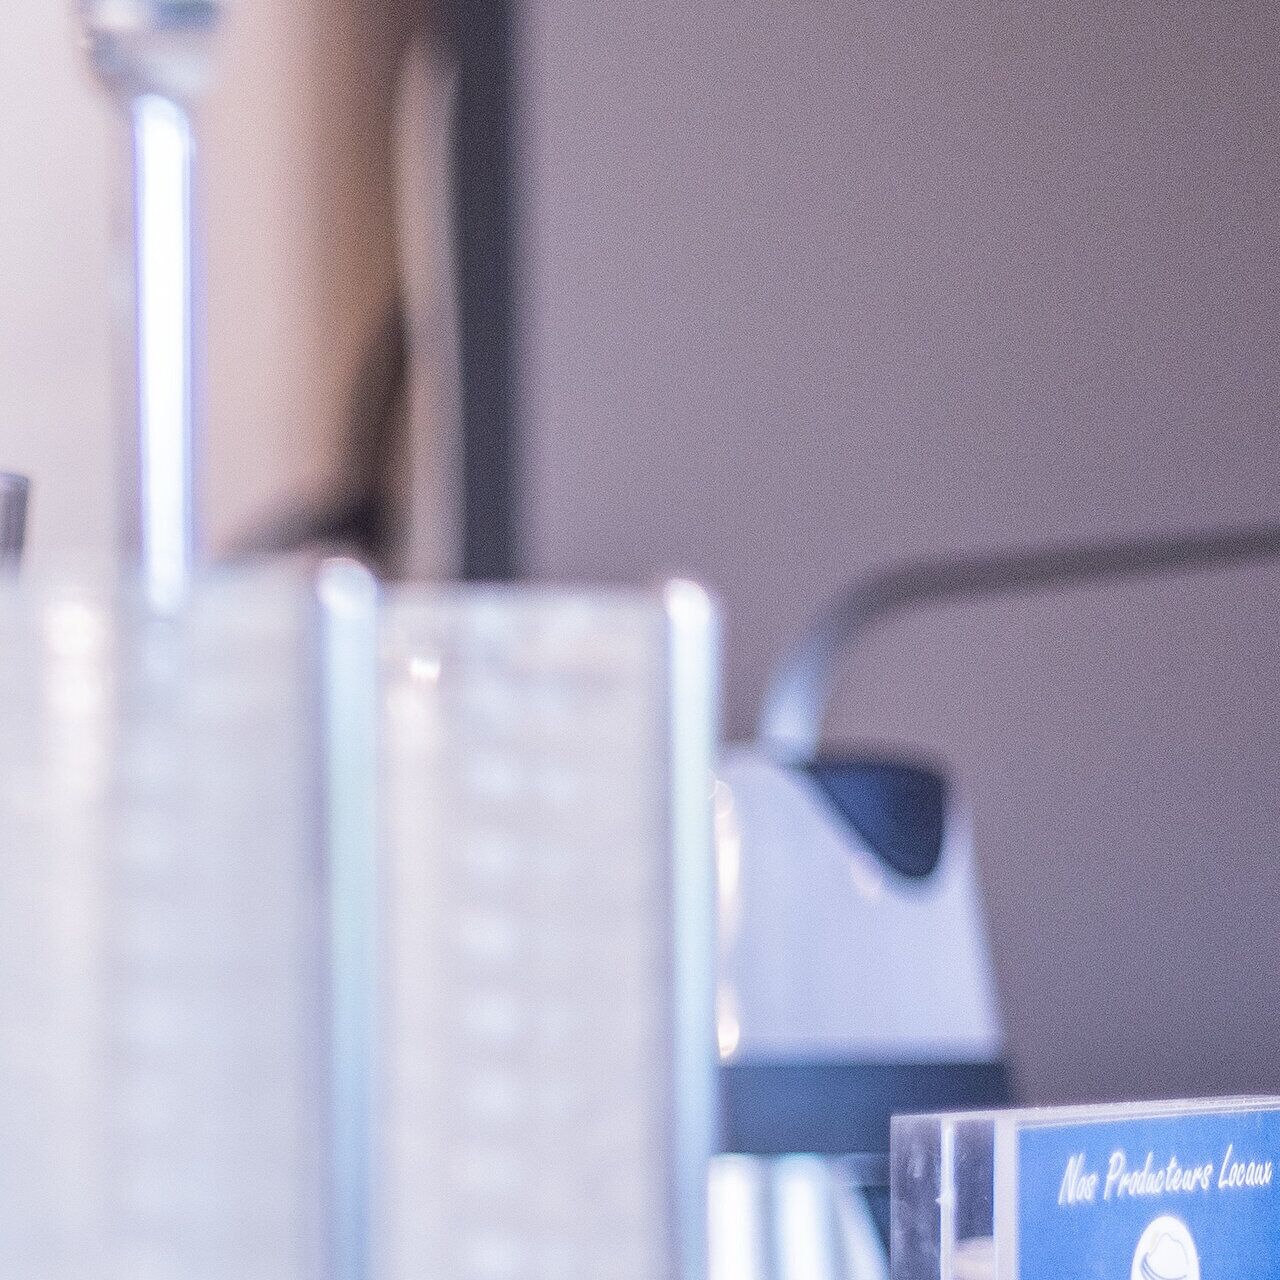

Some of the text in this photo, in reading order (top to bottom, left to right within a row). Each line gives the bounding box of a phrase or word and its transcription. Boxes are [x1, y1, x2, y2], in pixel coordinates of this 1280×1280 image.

[1057, 1143, 1273, 1205] Nos Producteurs Locaux
